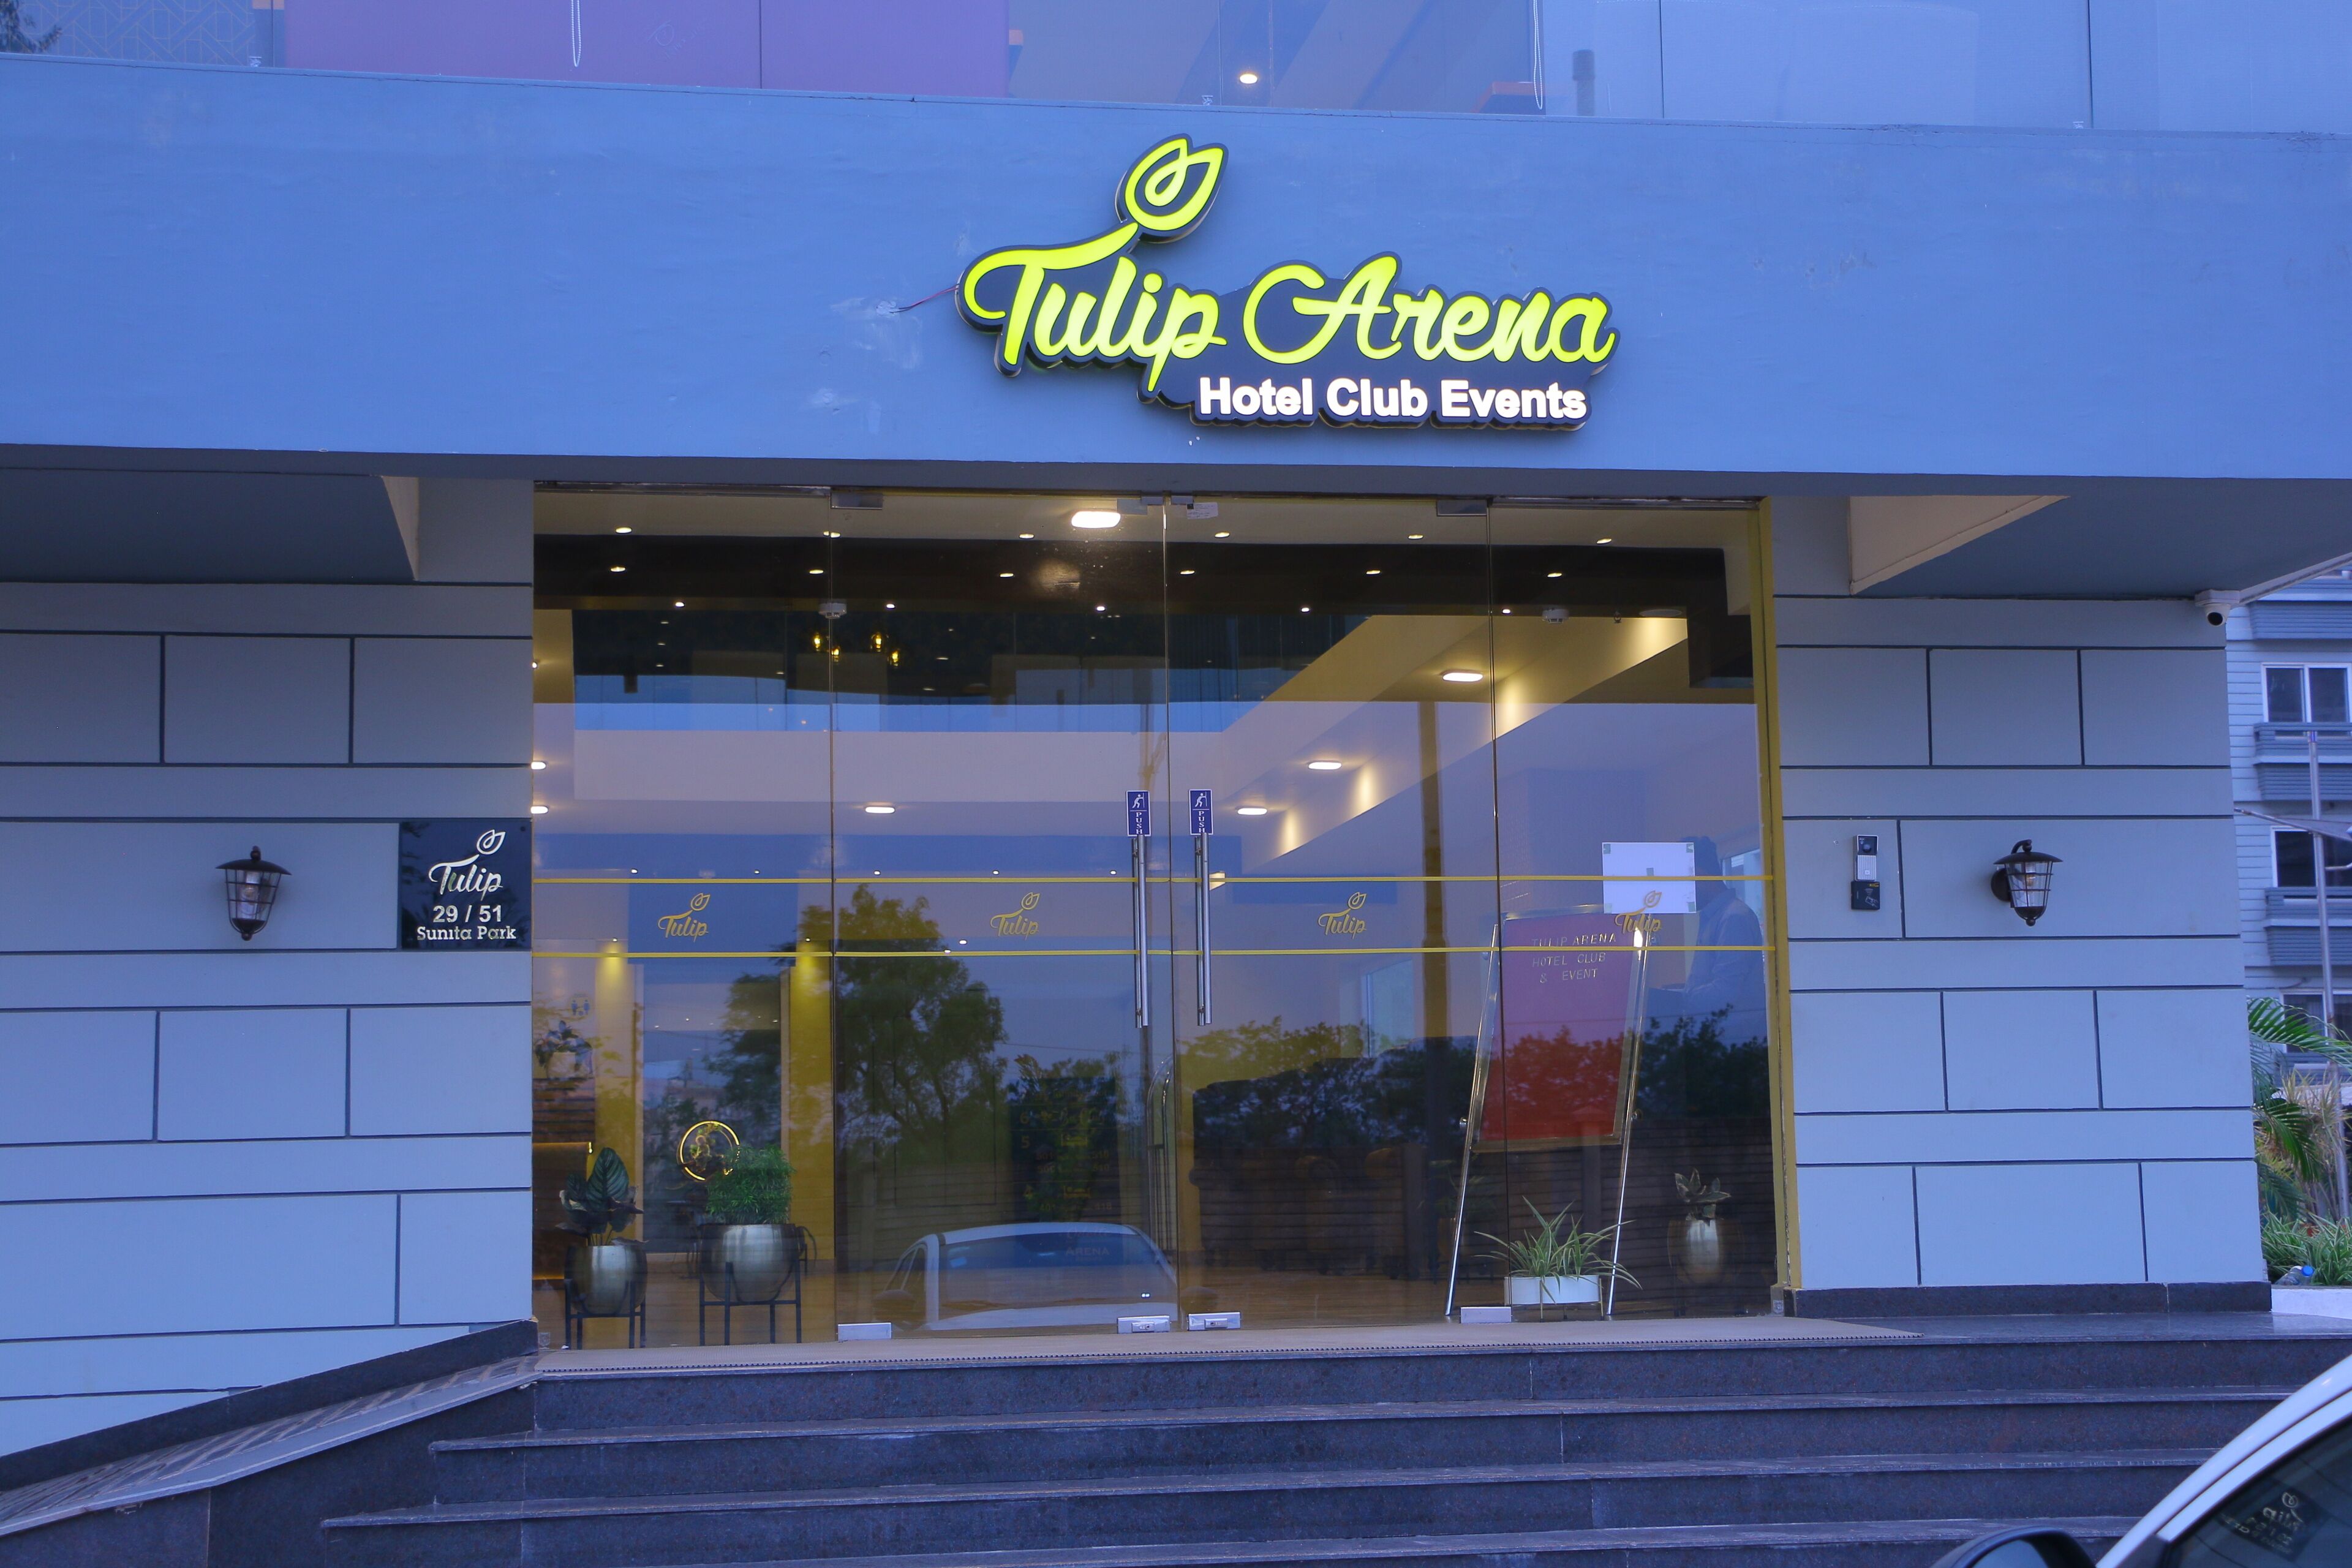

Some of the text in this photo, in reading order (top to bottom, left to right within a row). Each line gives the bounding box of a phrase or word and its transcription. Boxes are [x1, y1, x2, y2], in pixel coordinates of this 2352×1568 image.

[963, 222, 1616, 393] Tulip Arena
[1199, 377, 1588, 420] Hotel Club Events
[428, 854, 504, 902] Tulip
[432, 905, 458, 923] 29
[479, 905, 502, 923] 51
[657, 909, 709, 943] Tulip
[990, 908, 1039, 941] Tulip
[1317, 908, 1367, 940] Tulip
[1615, 907, 1662, 937] Tulip
[477, 925, 516, 940] Park
[1572, 932, 1616, 946] ARENA
[1532, 952, 1606, 967] HOTEL CLUB
[1562, 968, 1598, 981] EVENT
